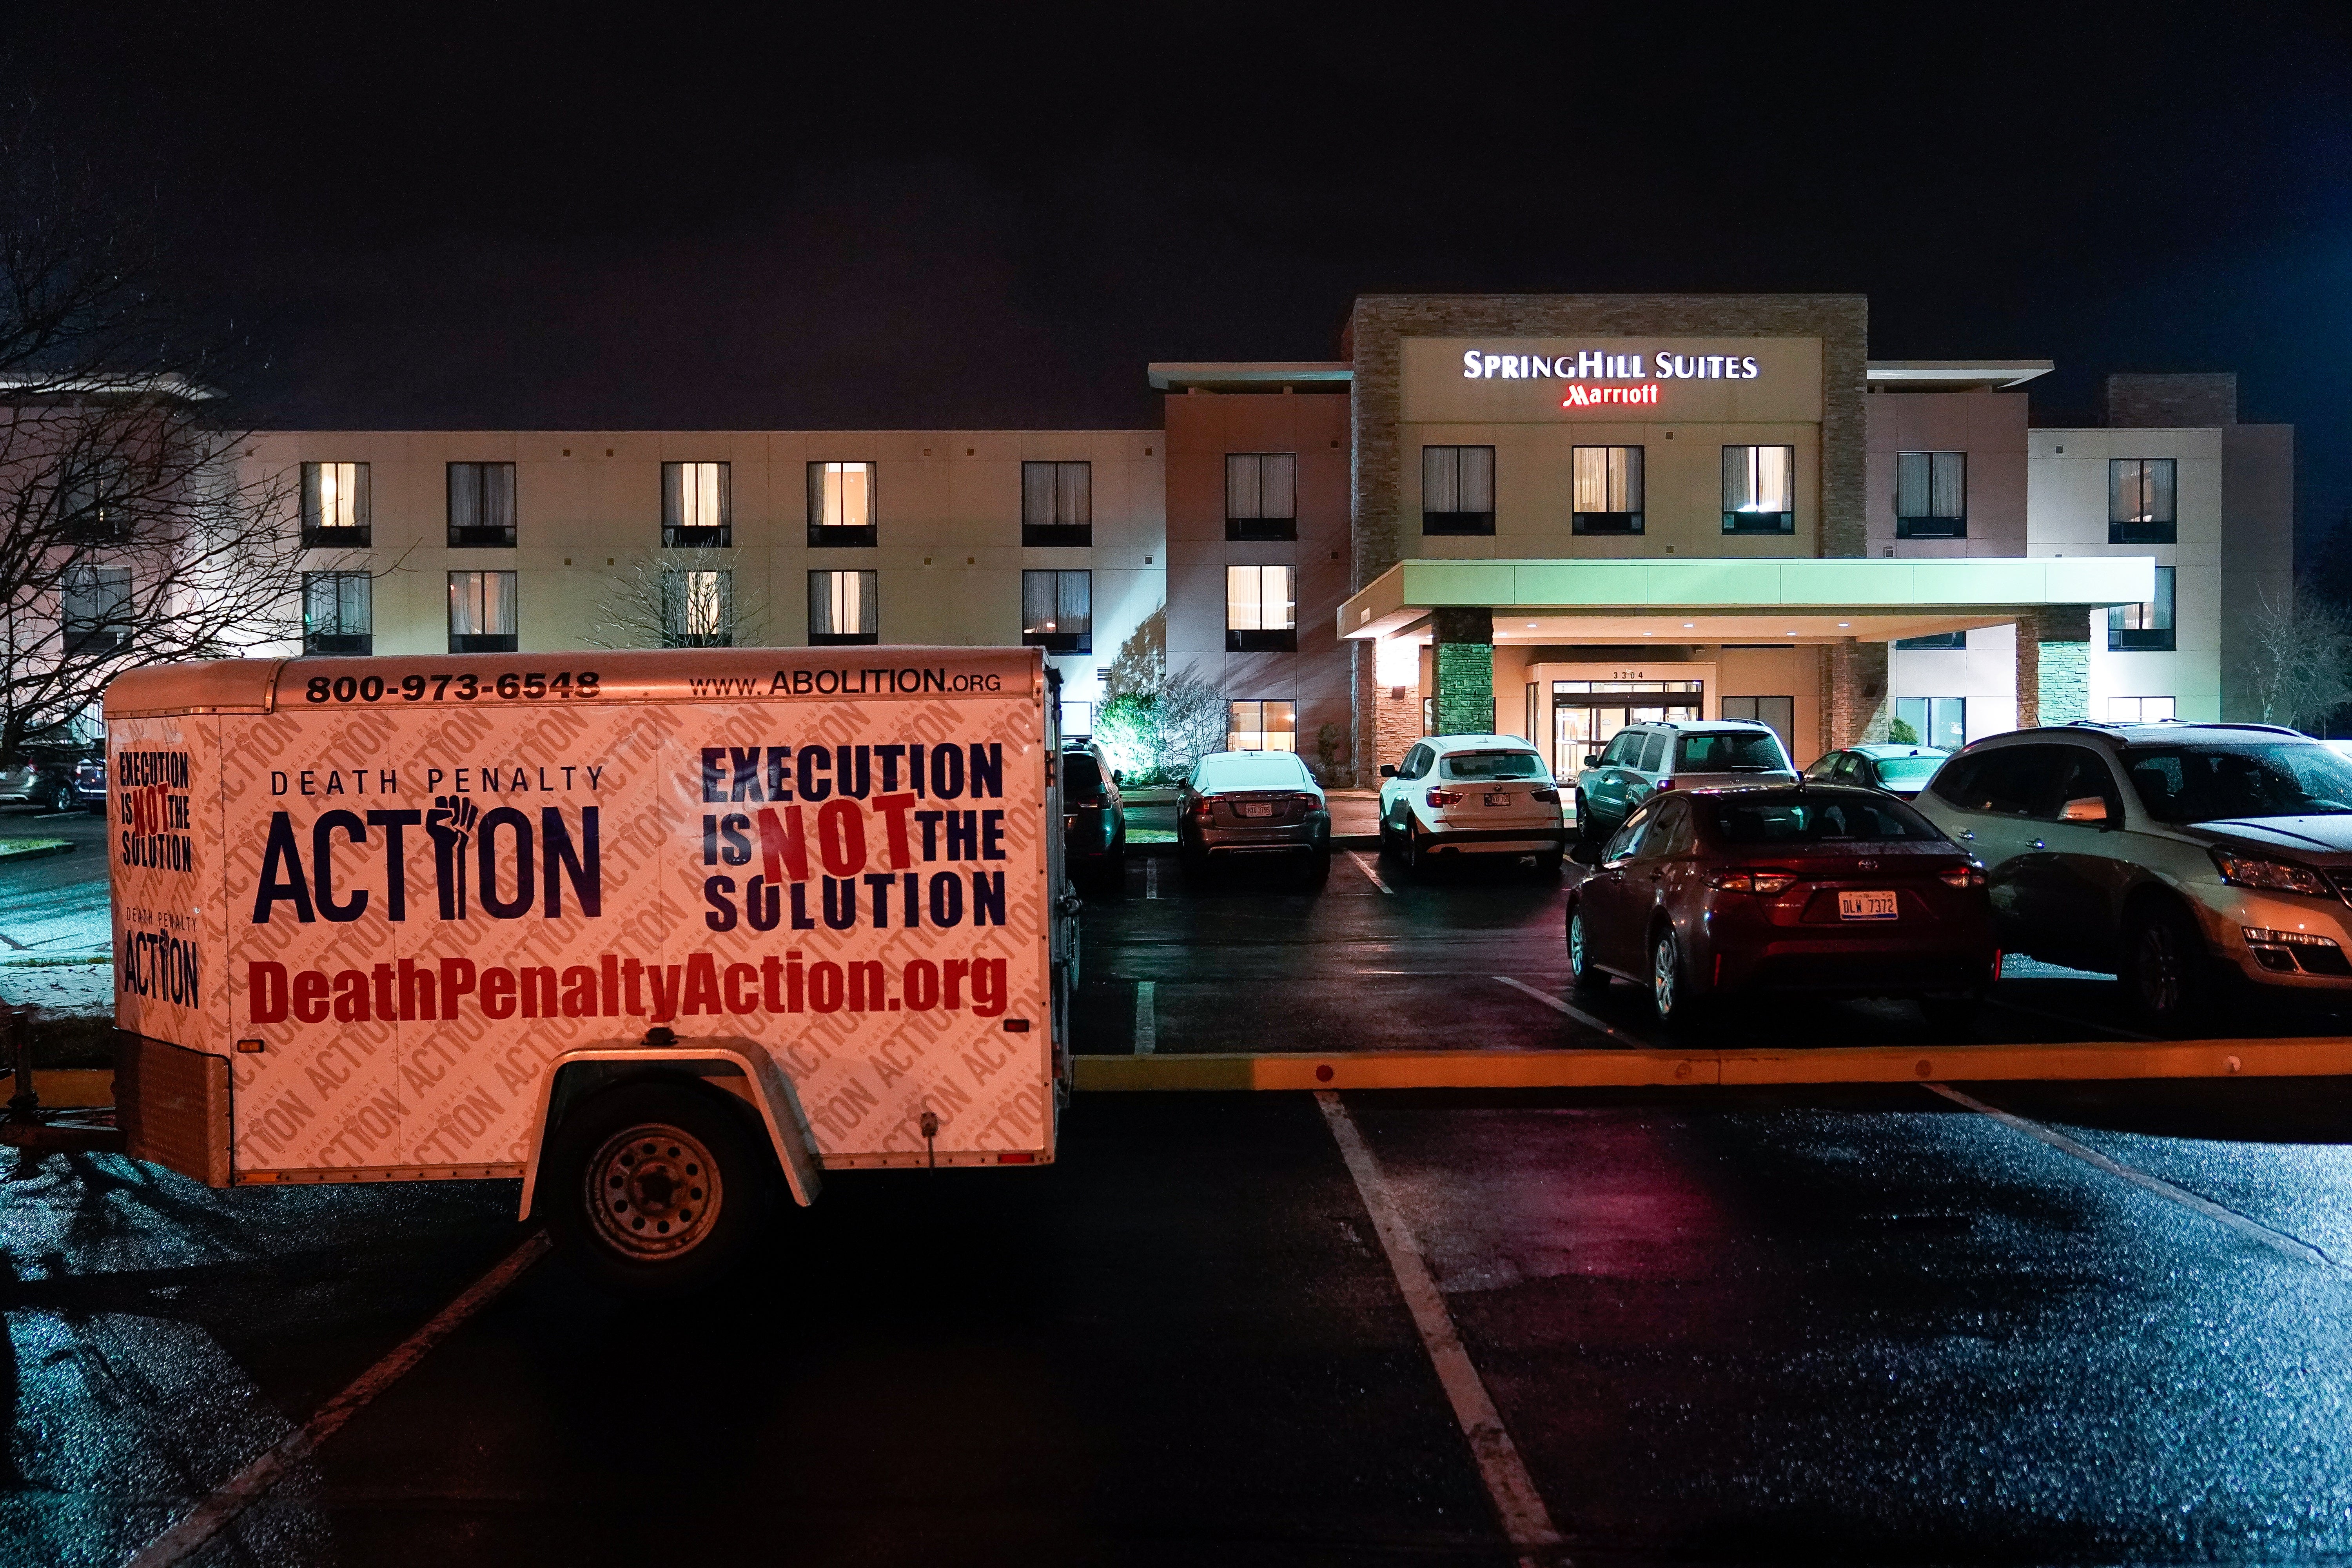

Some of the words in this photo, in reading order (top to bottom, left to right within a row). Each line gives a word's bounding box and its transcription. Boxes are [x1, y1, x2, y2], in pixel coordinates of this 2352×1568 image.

[1655, 352, 1757, 379] SUITES
[1563, 384, 1659, 406] Marriott
[306, 671, 601, 703] 800-973-6548
[769, 668, 1001, 695] ABOLITION.ORG
[119, 751, 189, 788] EXECUTION
[271, 769, 396, 795] DEATH
[428, 766, 603, 793] PENALTY
[701, 742, 1003, 803] EXECUTION
[121, 793, 132, 825] IS
[132, 782, 168, 837] NOT
[167, 795, 190, 829] THE
[122, 830, 191, 872] SOLUTION
[252, 795, 602, 924] ACTION
[702, 812, 751, 866] IS
[757, 792, 915, 884] NOT
[914, 809, 1006, 862] THE
[127, 907, 152, 924] DEATH
[158, 912, 196, 932] PENALTY
[703, 871, 1006, 933] SOLUTION
[1868, 898, 1894, 913] 7372
[124, 928, 198, 1009] ACTION
[249, 951, 1007, 1024] DeathPenaltyAction.org
[319, 1087, 411, 1163] CTION
[414, 1085, 505, 1163] CTION
